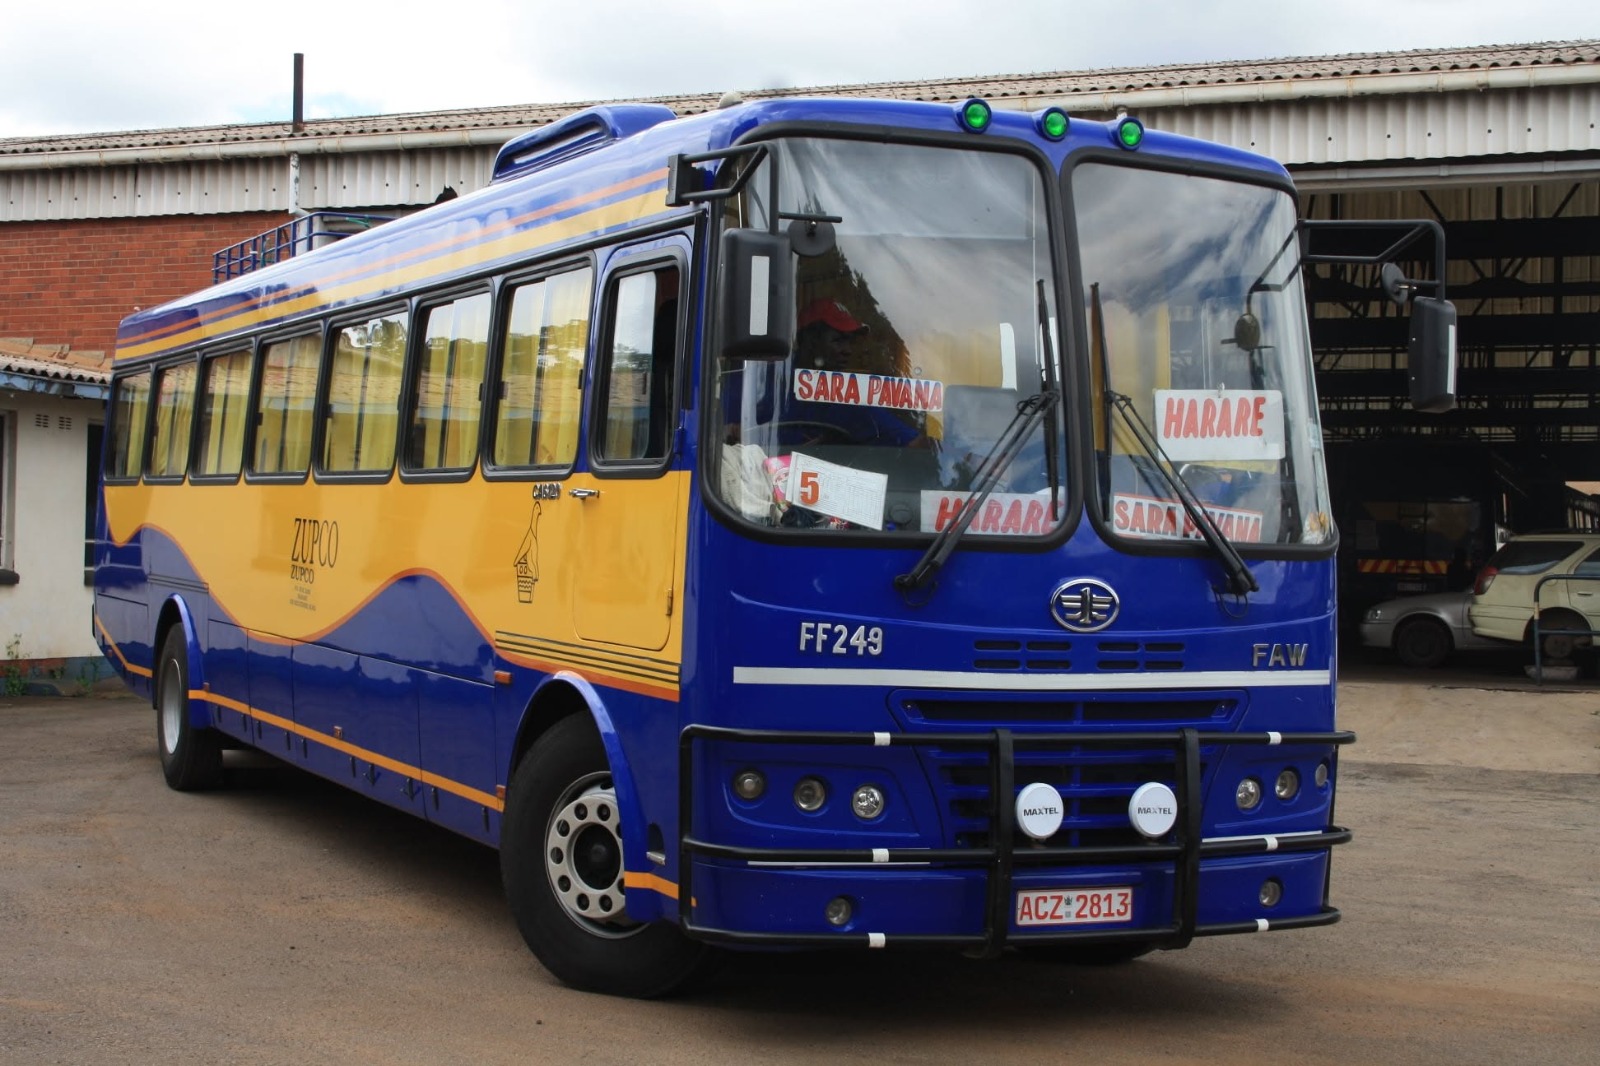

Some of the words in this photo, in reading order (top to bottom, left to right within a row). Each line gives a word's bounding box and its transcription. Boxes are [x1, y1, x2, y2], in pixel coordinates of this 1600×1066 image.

[798, 370, 860, 404] SARA
[867, 376, 943, 410] PAVANA
[1163, 396, 1266, 438] HARARE
[800, 471, 819, 504] 5
[1114, 500, 1177, 536] SARA
[291, 518, 338, 568] ZUPCO
[290, 564, 314, 584] ZUPCO
[800, 622, 883, 655] FF249
[1252, 643, 1308, 667] FAW
[1023, 806, 1059, 817] MAXTEL
[1137, 806, 1172, 815] MAXTEL
[1019, 894, 1063, 921] ACZ
[1075, 892, 1130, 918] 2813
